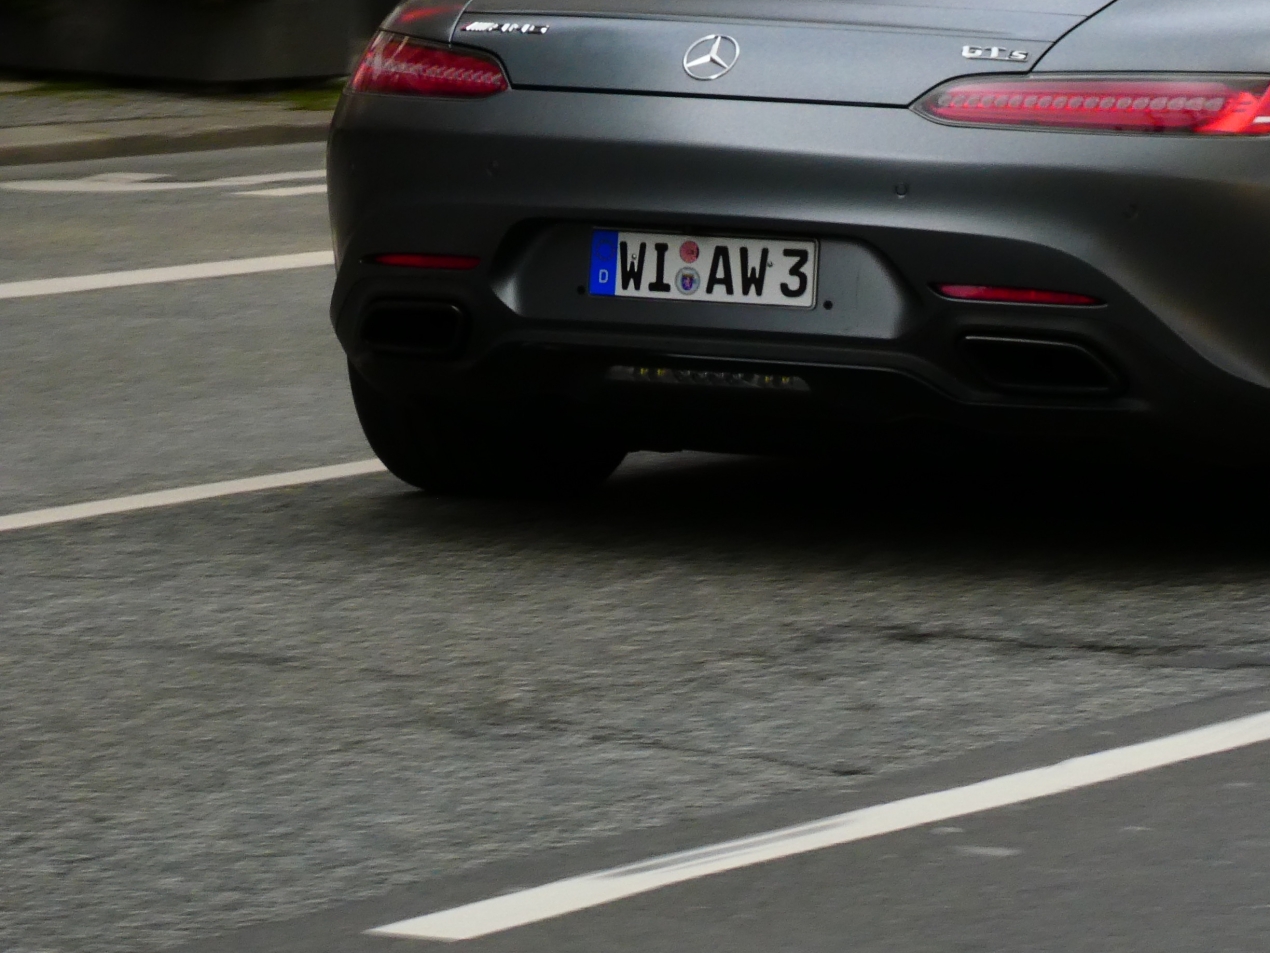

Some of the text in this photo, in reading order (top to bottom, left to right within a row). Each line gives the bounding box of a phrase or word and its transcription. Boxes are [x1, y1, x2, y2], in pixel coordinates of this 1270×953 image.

[598, 269, 609, 284] D
[619, 241, 809, 298] WI AW 3
